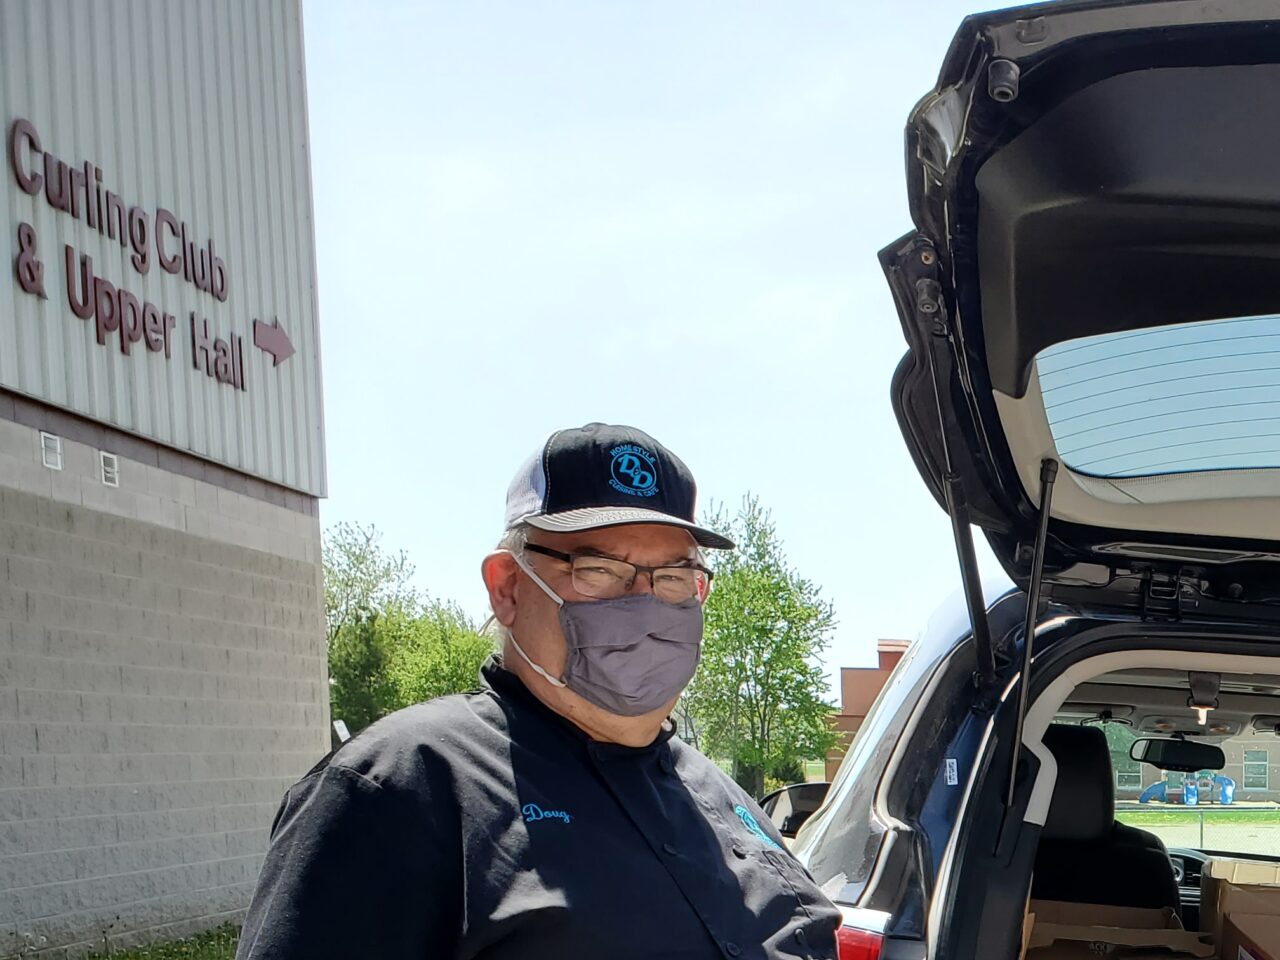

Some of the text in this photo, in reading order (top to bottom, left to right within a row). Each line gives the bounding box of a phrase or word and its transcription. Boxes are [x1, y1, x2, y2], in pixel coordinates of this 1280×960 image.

[10, 118, 229, 302] Curling Club
[16, 222, 247, 392] & Upper Hall
[522, 803, 571, 824] Doug
